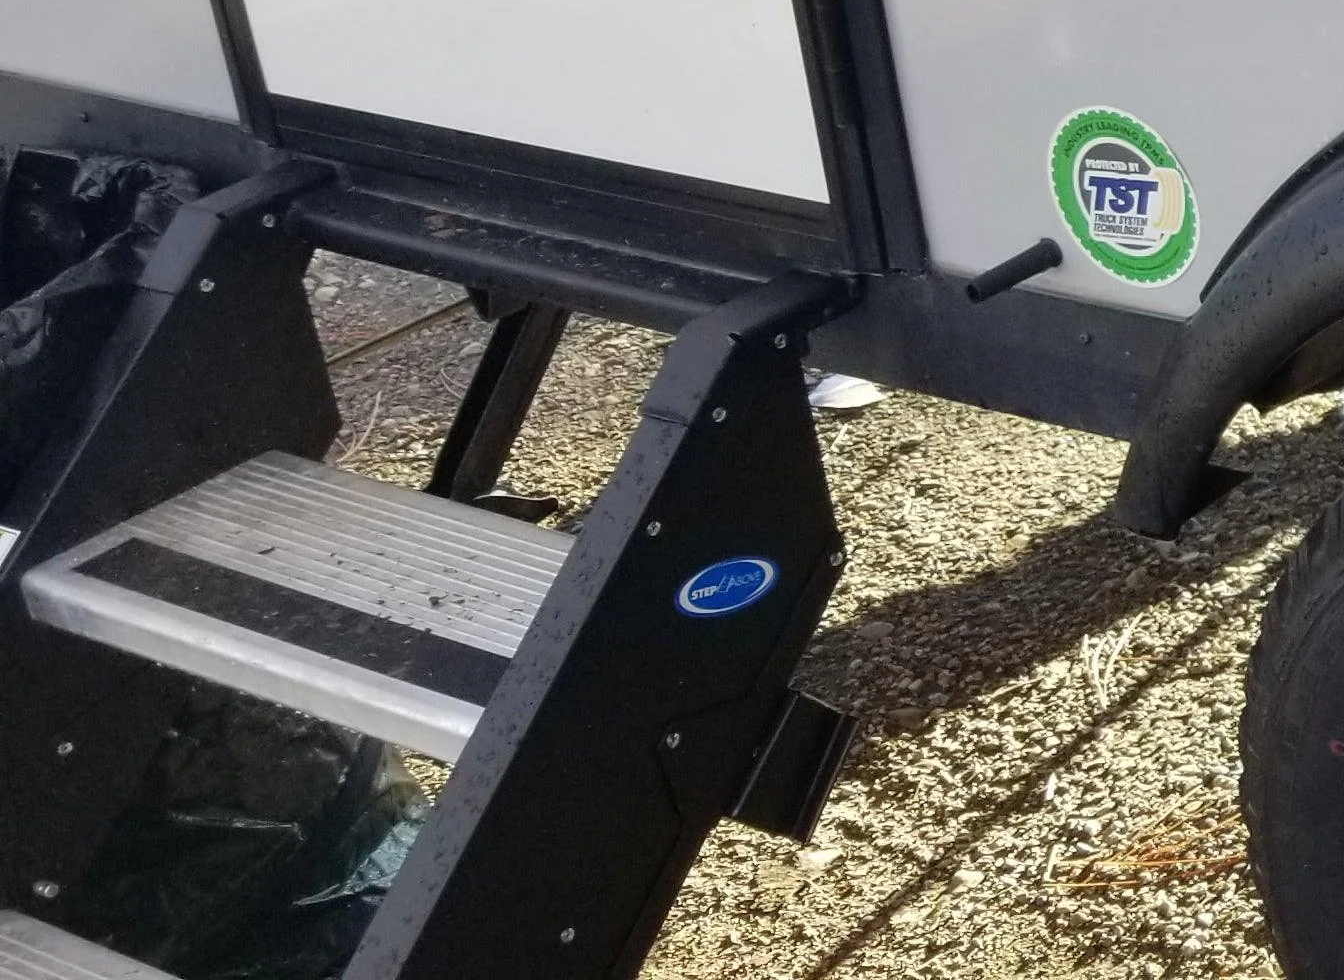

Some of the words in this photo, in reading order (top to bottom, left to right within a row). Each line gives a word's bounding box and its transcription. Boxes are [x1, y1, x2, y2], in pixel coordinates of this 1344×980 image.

[1064, 121, 1094, 158] INDUSTRY
[1097, 121, 1139, 141] LEADING
[1088, 176, 1159, 215] TST
[1094, 213, 1116, 224] TRUCK
[1119, 215, 1148, 226] SYSTEM
[1094, 223, 1145, 236] TECHNOLOGIES
[690, 585, 717, 601] STEP
